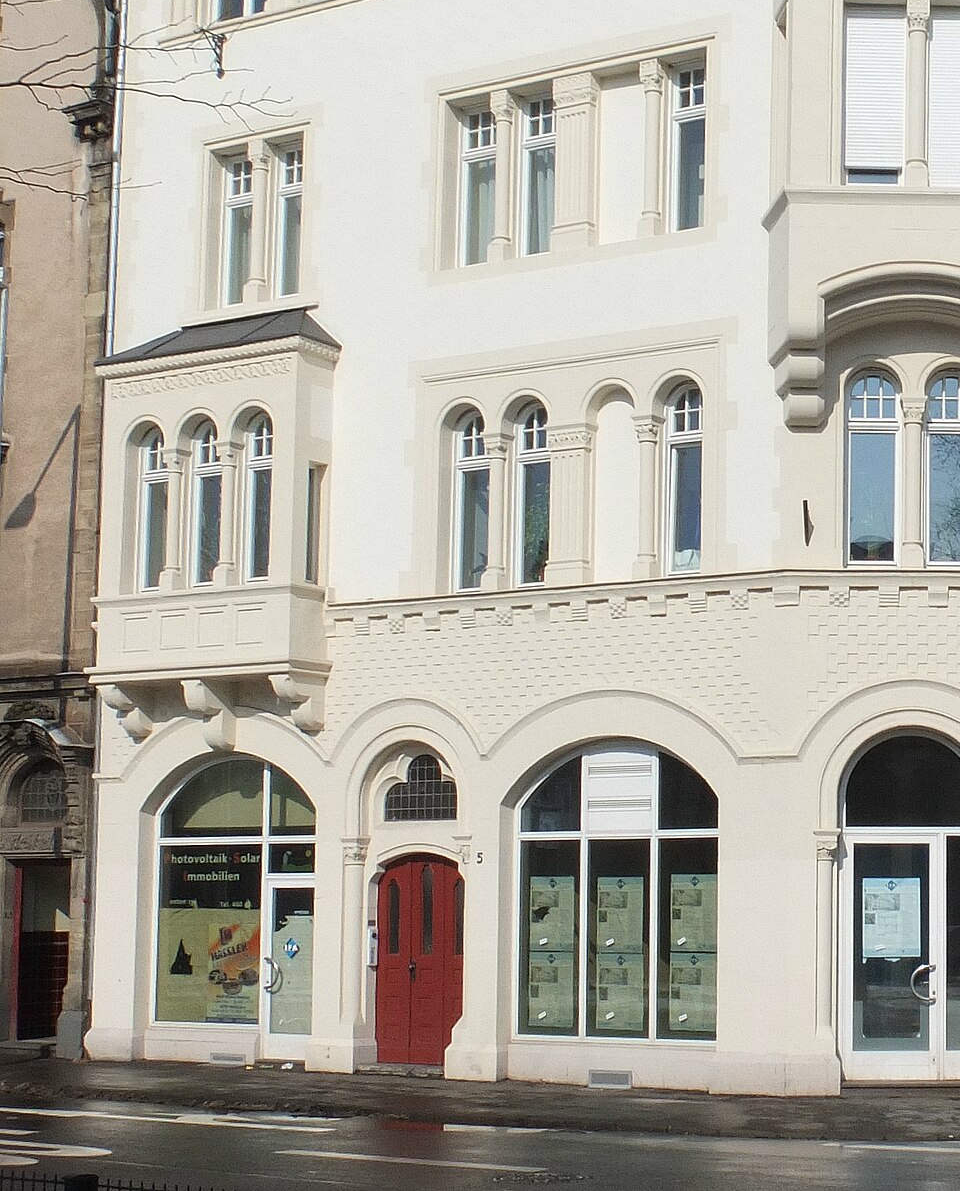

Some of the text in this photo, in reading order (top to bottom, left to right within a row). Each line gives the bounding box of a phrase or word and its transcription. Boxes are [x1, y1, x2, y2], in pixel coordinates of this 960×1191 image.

[164, 852, 260, 864] Photovoltaik Solar
[476, 852, 483, 864] 5
